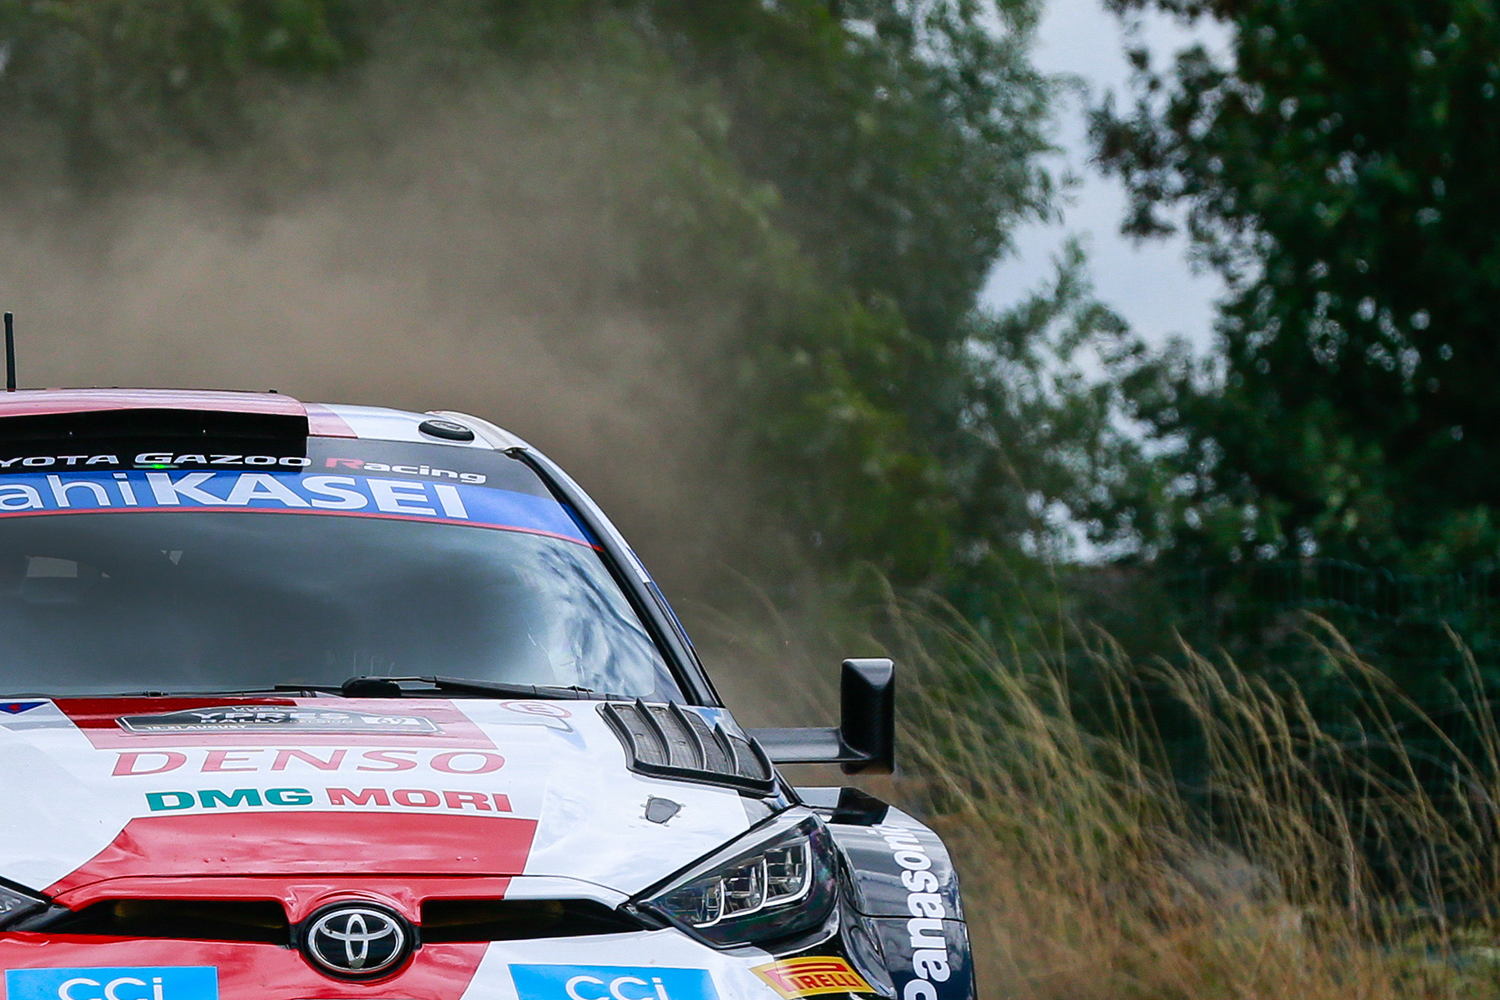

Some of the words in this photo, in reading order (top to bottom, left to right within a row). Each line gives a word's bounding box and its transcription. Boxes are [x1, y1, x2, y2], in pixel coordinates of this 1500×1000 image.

[135, 451, 312, 468] GAZOO
[326, 458, 487, 484] Racing
[111, 749, 505, 776] DENSO
[145, 789, 313, 811] DMG
[326, 788, 513, 812] MORI
[764, 962, 862, 993] PIRELLI
